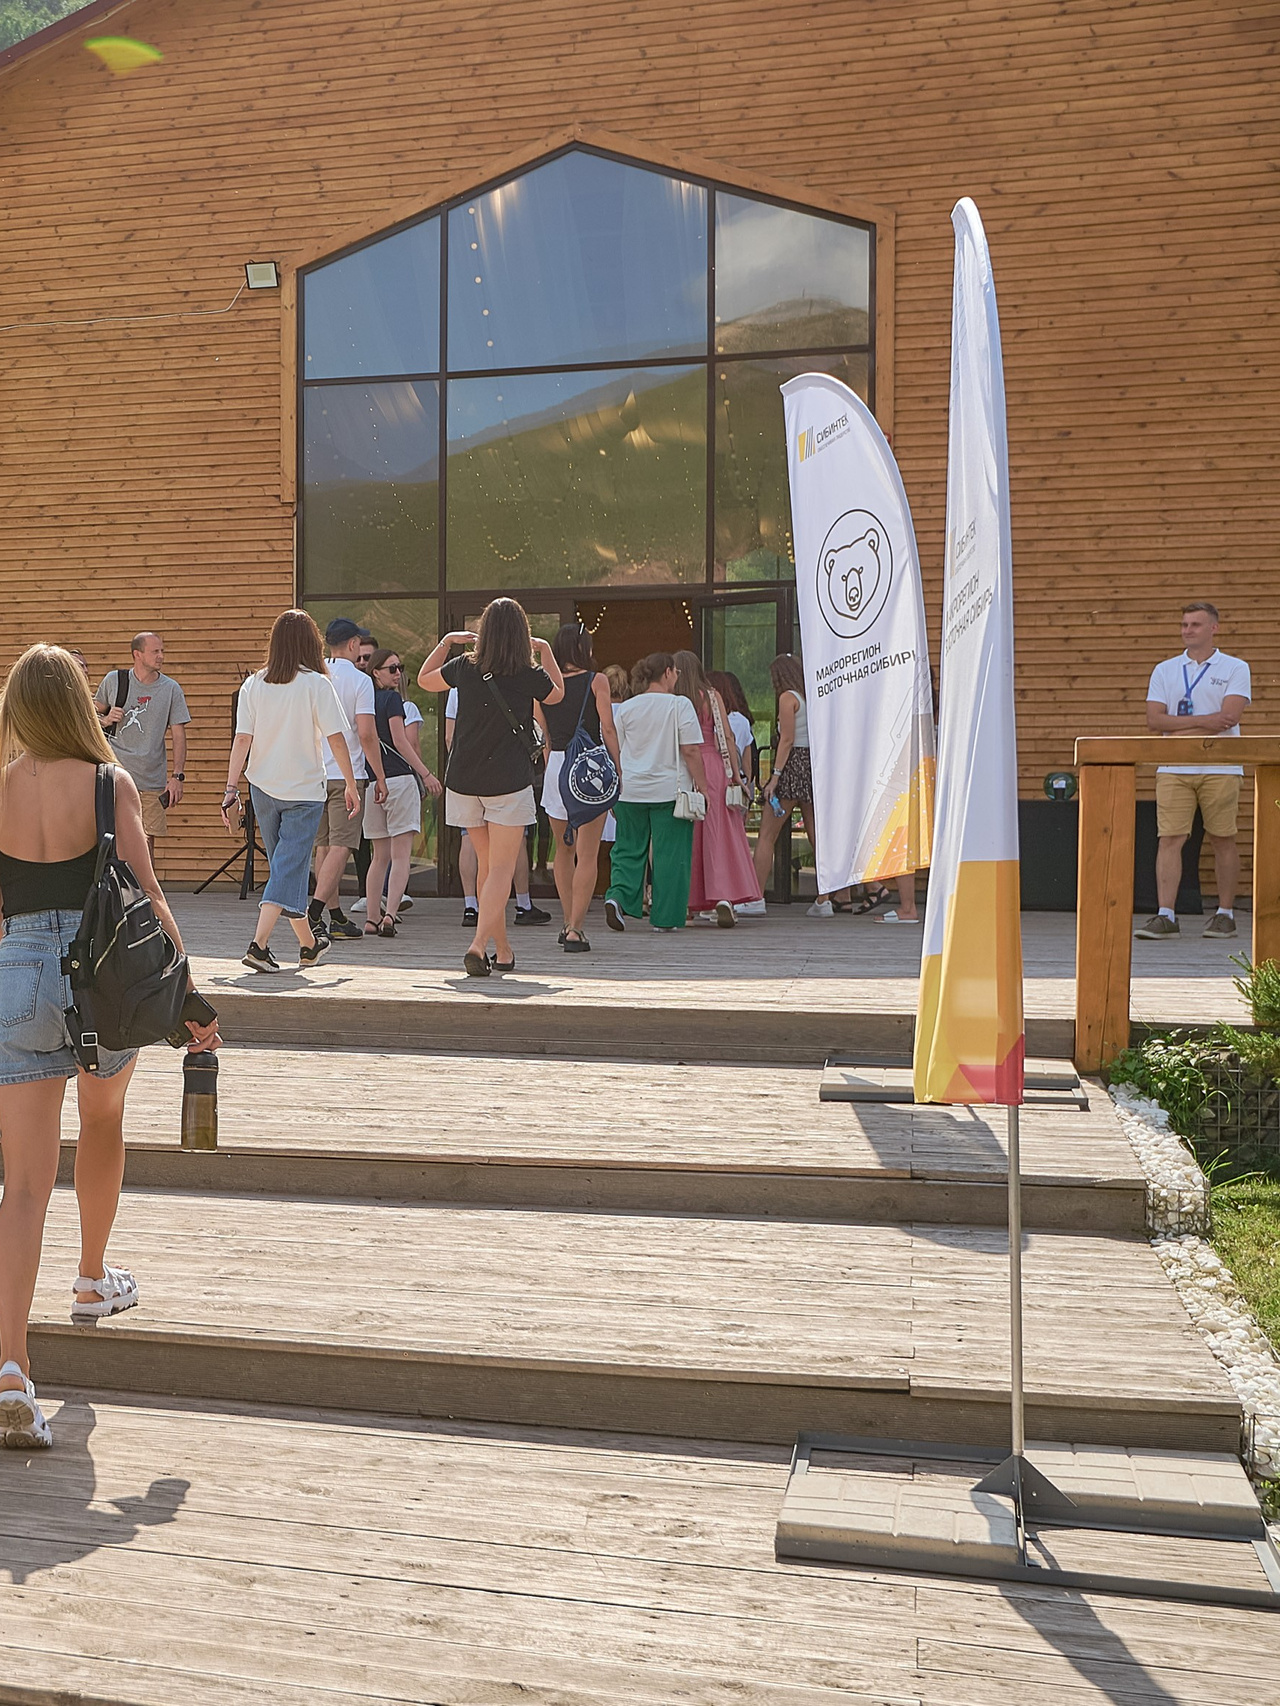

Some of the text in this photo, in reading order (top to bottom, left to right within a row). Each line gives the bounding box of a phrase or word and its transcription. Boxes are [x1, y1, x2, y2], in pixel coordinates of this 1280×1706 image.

[816, 412, 849, 443] СИБИНТЕК
[816, 641, 881, 681] МАКРОРЕГИОН
[817, 665, 869, 698] ВОСТОЧНАЯ
